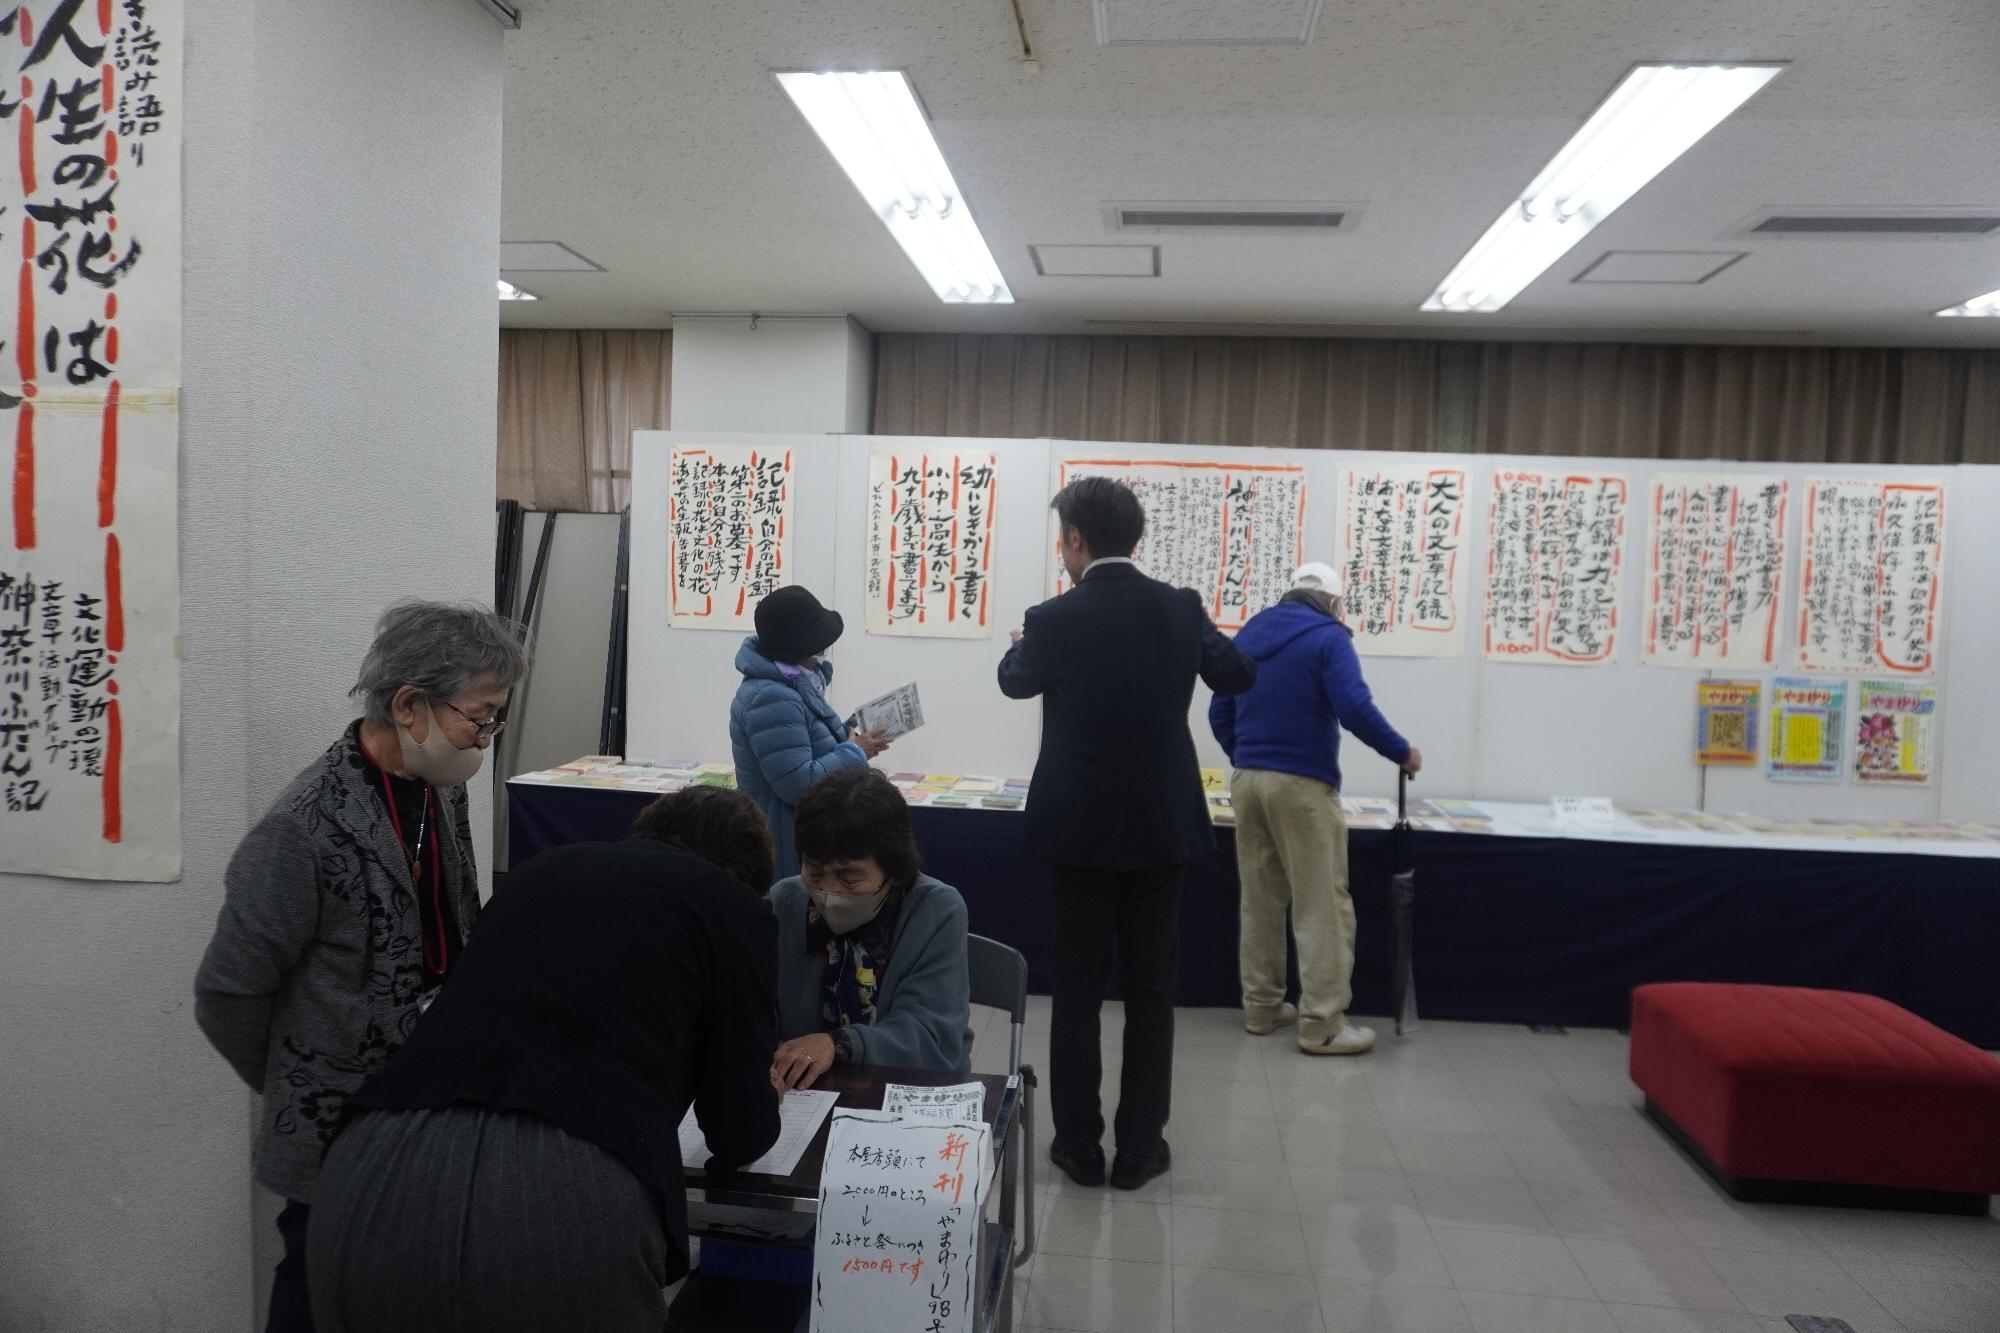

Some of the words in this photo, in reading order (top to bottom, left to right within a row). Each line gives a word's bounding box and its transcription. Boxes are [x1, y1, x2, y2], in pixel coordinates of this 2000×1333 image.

[953, 464, 994, 619] 幼いときから書く
[1221, 478, 1254, 607] 神奈川ふだん記
[0, 571, 50, 813] 神奈川ふだん記
[931, 1132, 971, 1206] 新刊
